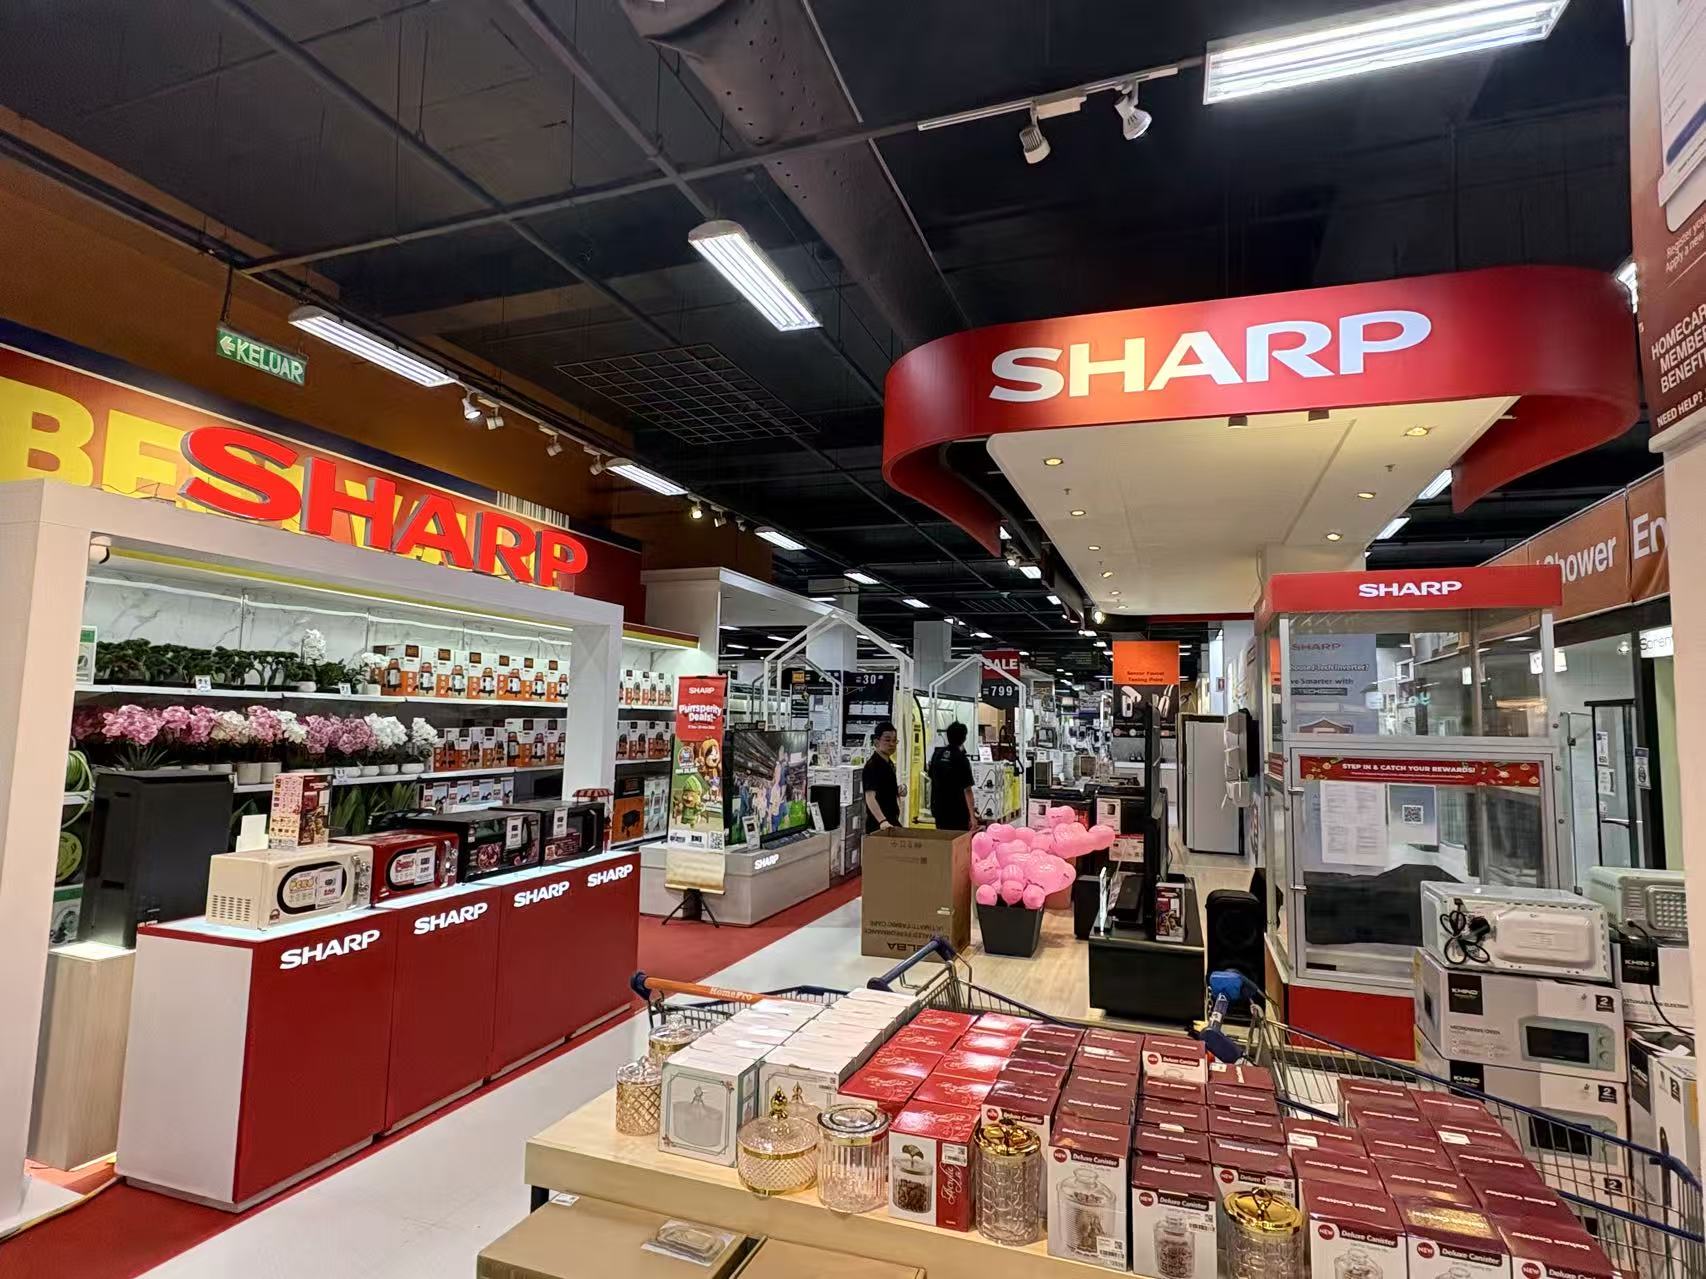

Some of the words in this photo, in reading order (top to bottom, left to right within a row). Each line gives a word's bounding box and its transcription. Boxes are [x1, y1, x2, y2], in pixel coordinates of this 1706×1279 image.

[1690, 229, 1705, 250] new
[236, 339, 305, 384] KELUAR
[989, 310, 1432, 402] SHARP
[1657, 407, 1678, 428] NEED
[1678, 391, 1703, 416] HELP?
[178, 426, 588, 588] SHARP
[1358, 580, 1463, 598] SHARP
[1290, 643, 1342, 651] SHARP
[863, 674, 877, 685] 30
[990, 685, 1013, 697] 799
[1432, 765, 1476, 773] REWARDS!
[755, 853, 779, 870] SHARP
[587, 863, 633, 888] SHARP
[513, 880, 570, 908] SHARP
[414, 902, 488, 935] SHARP
[280, 929, 380, 970] SHARP
[710, 987, 753, 1000] HomePro
[1600, 997, 1609, 1006] 2
[1163, 1056, 1179, 1064] Deluxe
[1179, 1058, 1199, 1066] Canister
[1602, 1087, 1611, 1096] 2
[1054, 1151, 1067, 1160] NEW
[1073, 1153, 1093, 1162] Deluxe
[1093, 1155, 1118, 1166] Canister
[1240, 1174, 1260, 1183] Deluxe
[1608, 1180, 1617, 1188] 2
[1139, 1195, 1154, 1204] NEW
[1159, 1197, 1182, 1206] Deluxe
[1182, 1200, 1208, 1210] Canister
[1318, 1227, 1335, 1238] NEW
[1341, 1229, 1366, 1241] Deluxe
[1366, 1234, 1396, 1246] Canister
[1417, 1245, 1435, 1256] NEW
[1442, 1248, 1467, 1260] Deluxe
[1468, 1253, 1500, 1266] Canister
[1522, 1264, 1540, 1276] NEW
[1549, 1268, 1575, 1279] Deluxe
